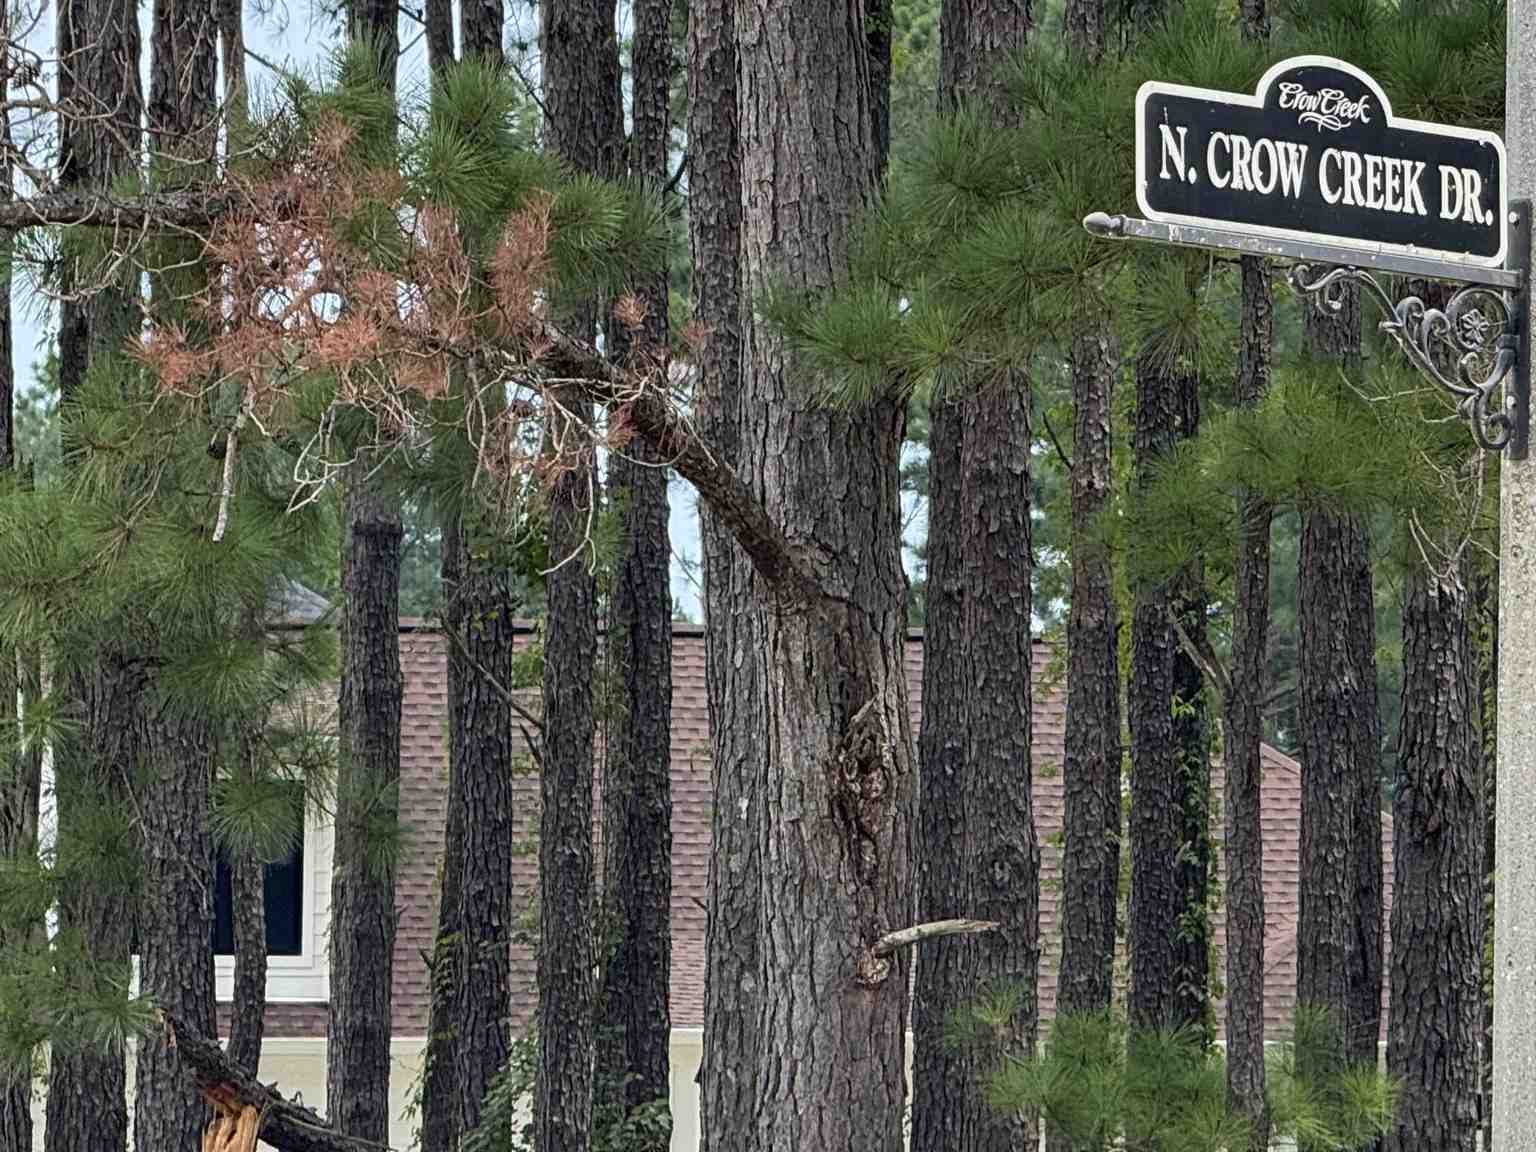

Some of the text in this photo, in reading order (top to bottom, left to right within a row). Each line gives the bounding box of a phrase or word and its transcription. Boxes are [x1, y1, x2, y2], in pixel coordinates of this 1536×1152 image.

[1278, 81, 1371, 123] Crow Creek
[1159, 124, 1494, 227] N. CROW CREEK DR.
